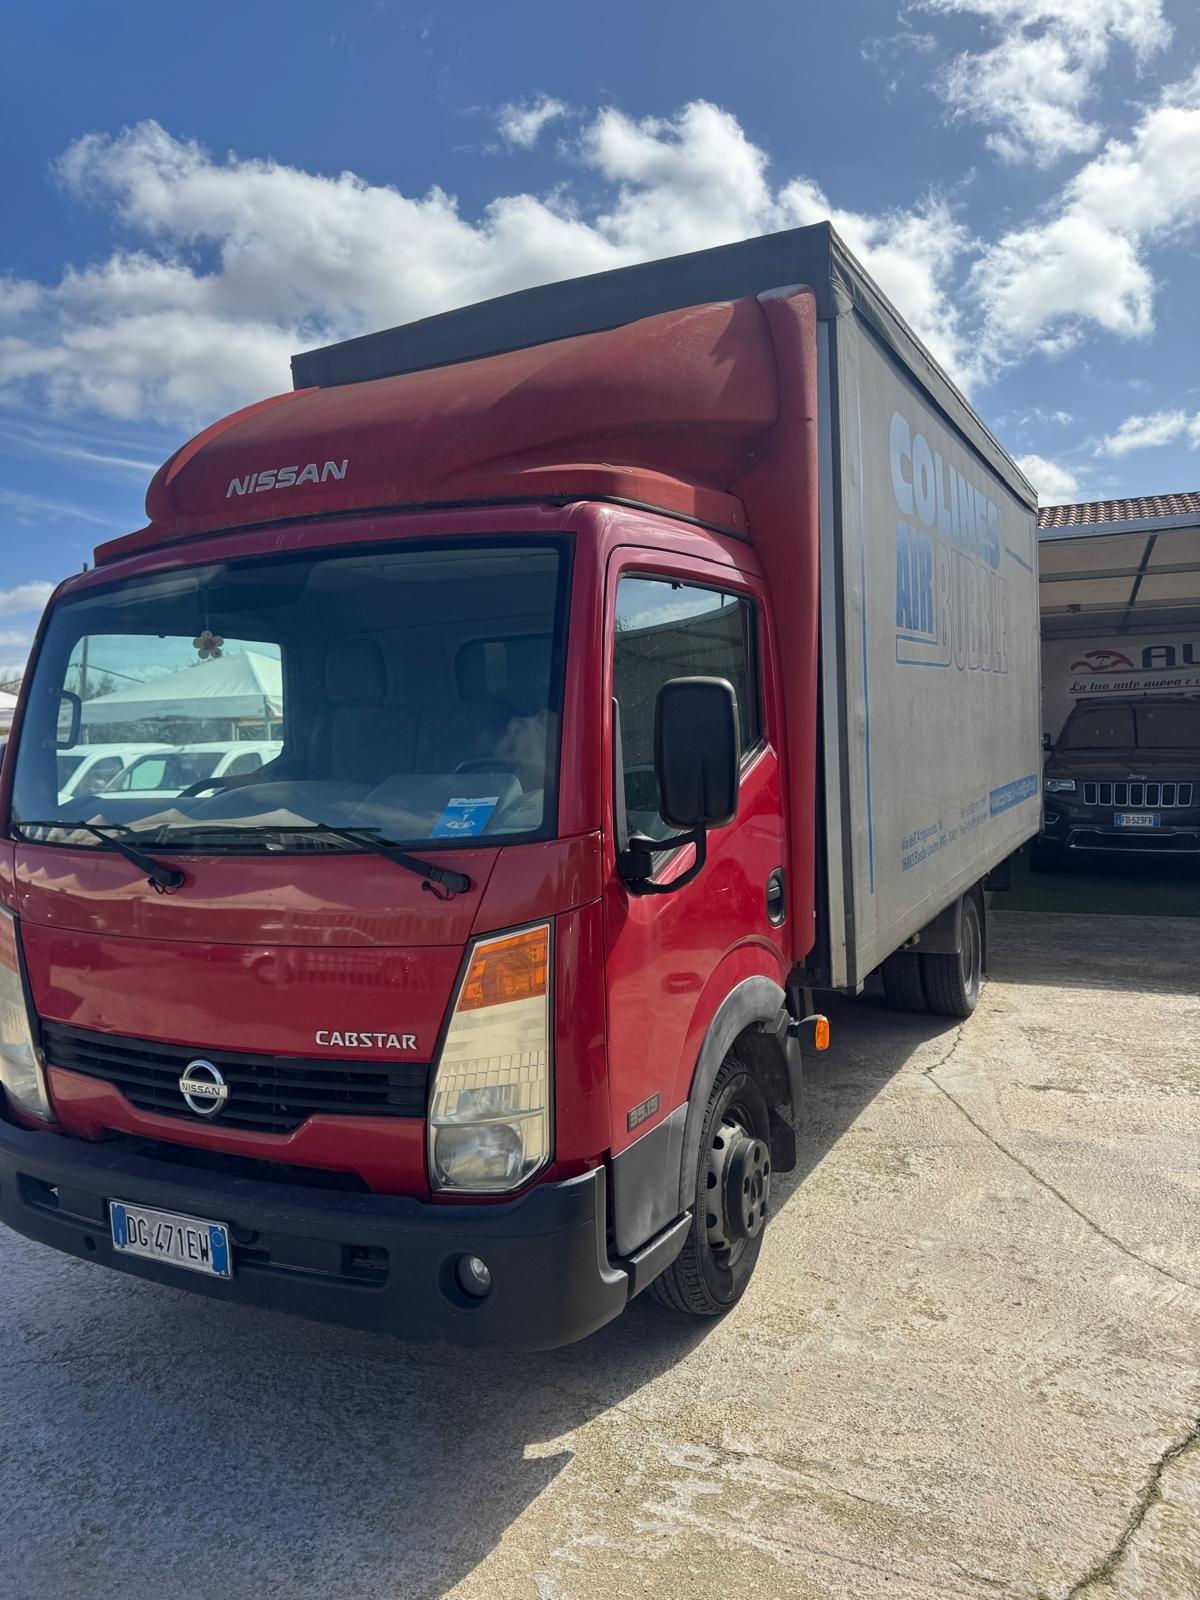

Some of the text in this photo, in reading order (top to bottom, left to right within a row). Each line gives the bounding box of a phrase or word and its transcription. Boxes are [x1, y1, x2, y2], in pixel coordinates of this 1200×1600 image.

[226, 459, 348, 498] NISSAN
[890, 411, 1001, 570] COLINES
[896, 520, 934, 634] AIR
[936, 540, 1008, 674] BUBBLE
[1069, 680, 1086, 691] La
[1090, 681, 1109, 691] tua
[1113, 680, 1140, 689] auto
[315, 1030, 417, 1050] CABSTAR
[181, 1081, 220, 1096] NISSAN
[127, 1215, 148, 1247] DG
[155, 1222, 209, 1262] 471EW
